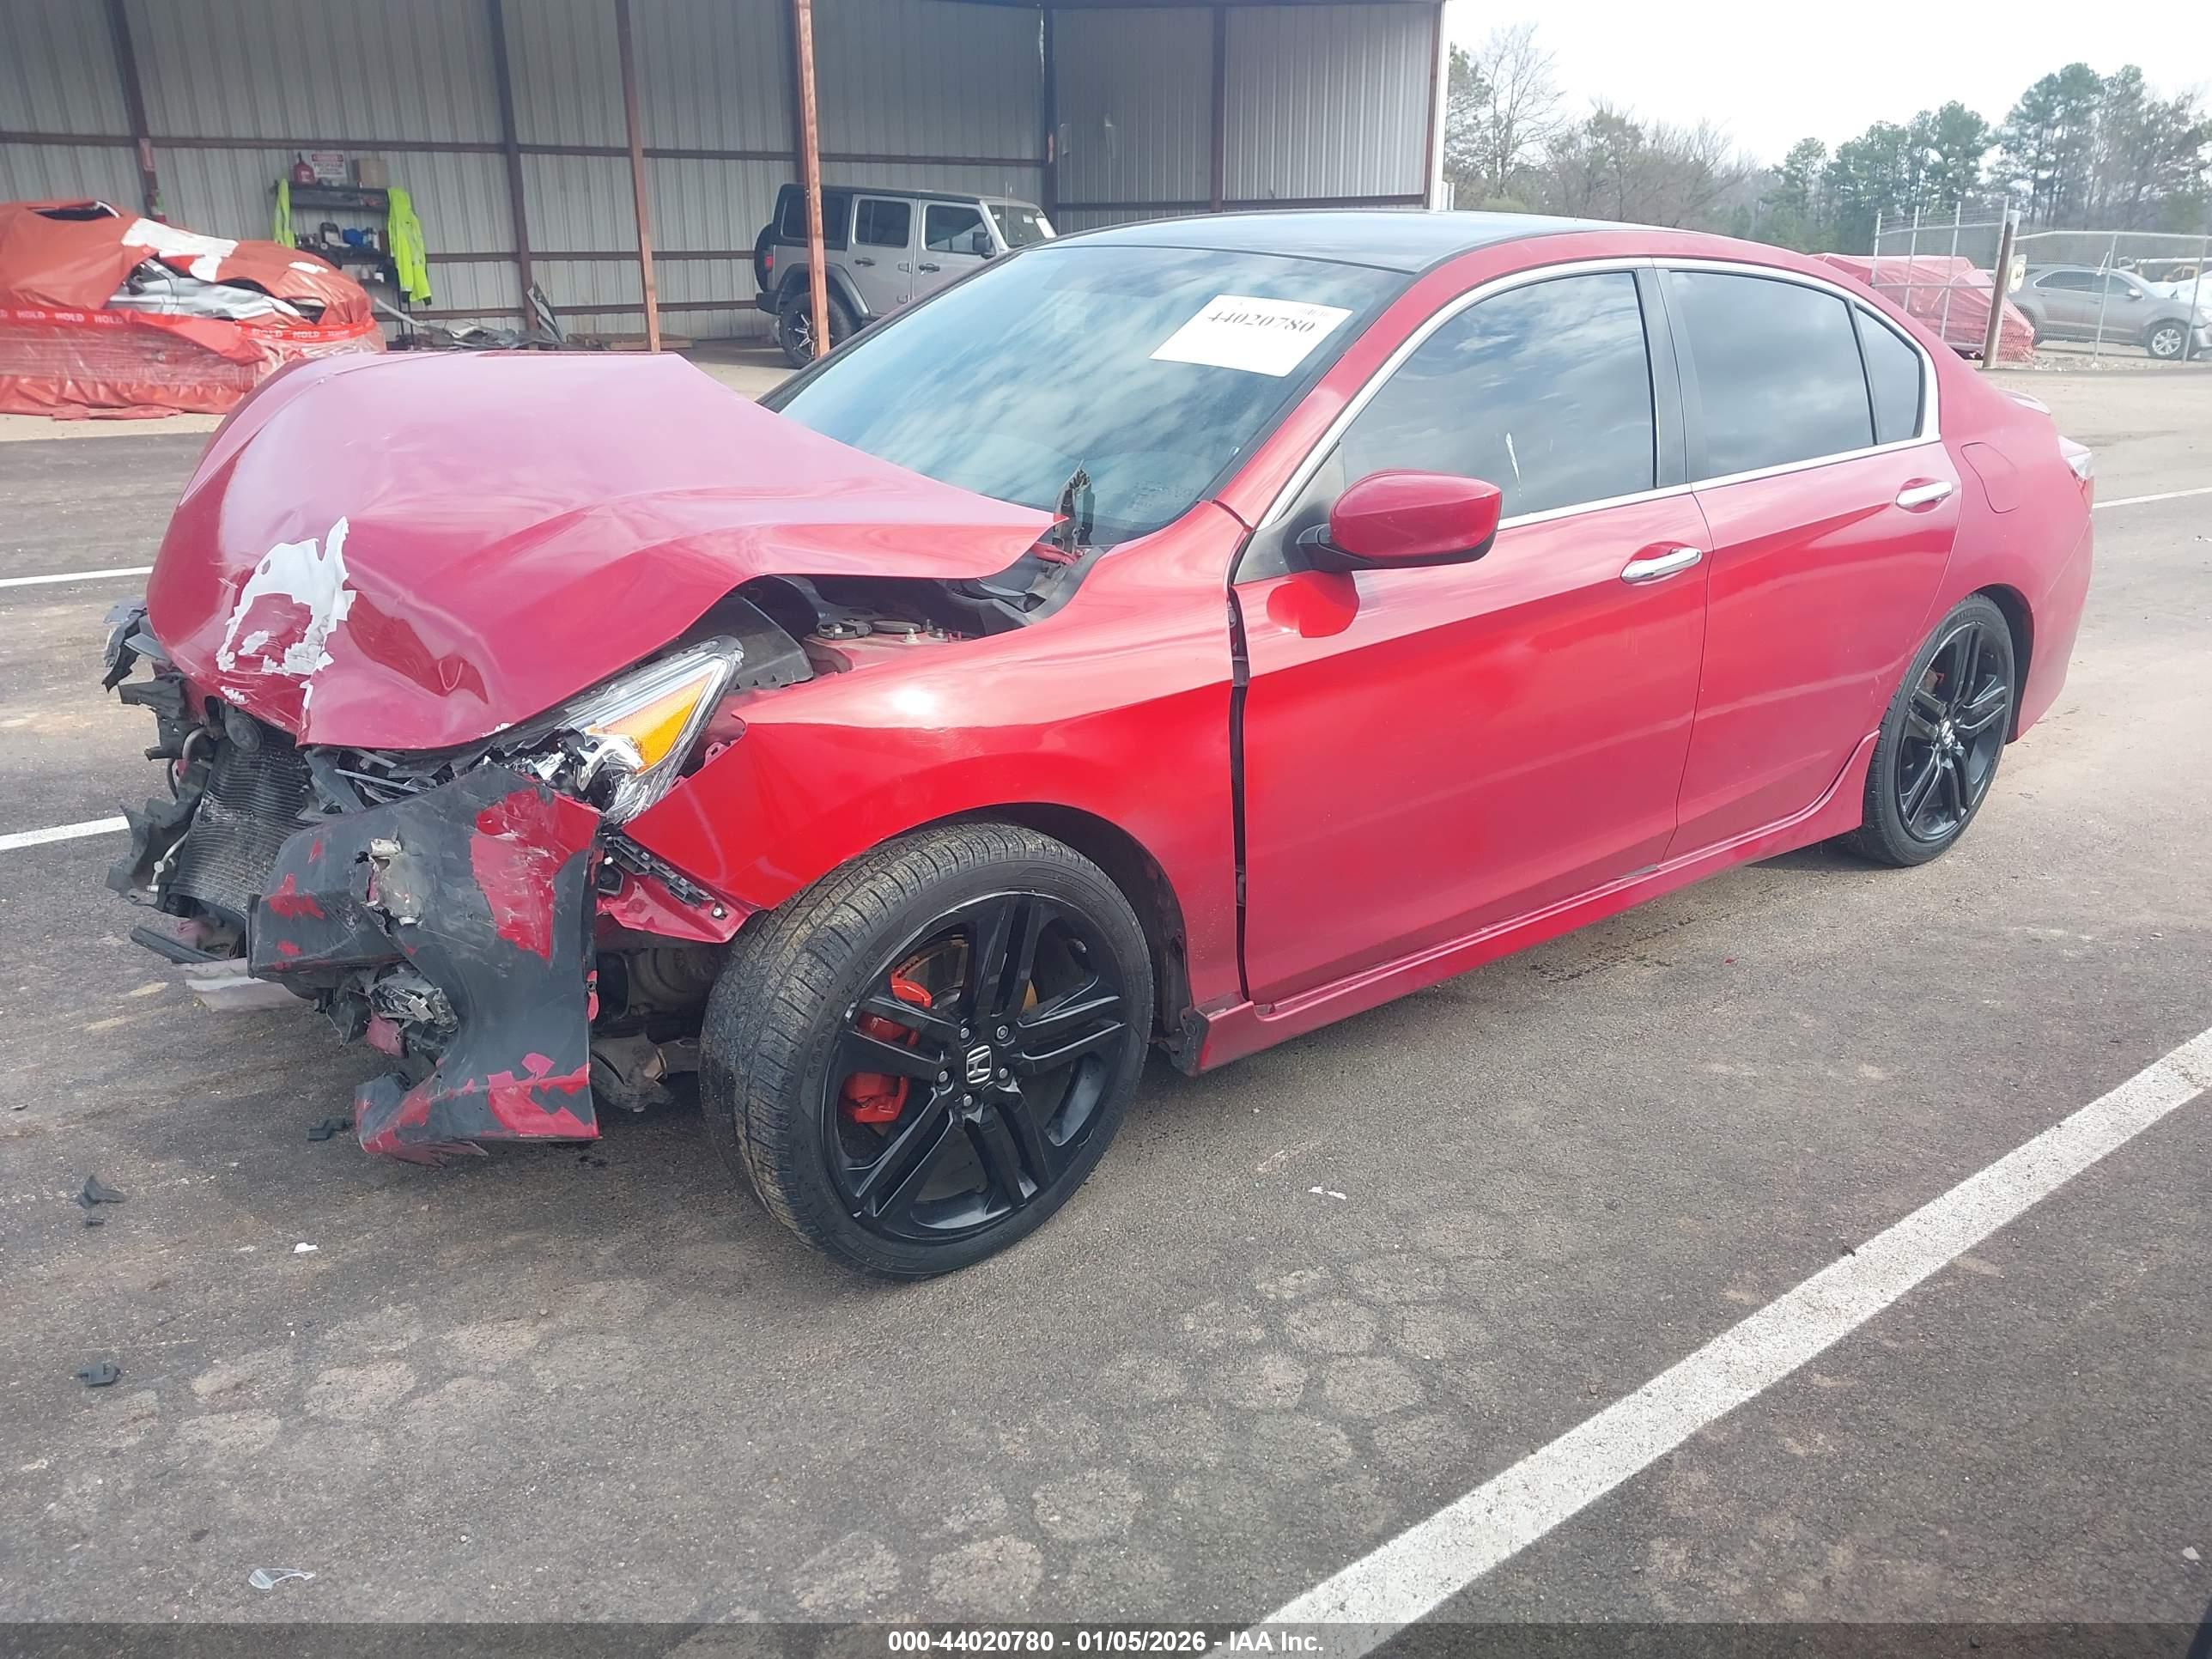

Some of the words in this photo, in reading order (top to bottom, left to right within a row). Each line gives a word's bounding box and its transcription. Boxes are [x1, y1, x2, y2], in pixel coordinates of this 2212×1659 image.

[16, 310, 46, 319] HOLD
[54, 312, 85, 322] HOLD
[94, 314, 124, 324] HOLD
[1207, 310, 1317, 333] 44020780
[292, 330, 320, 339] HOLD
